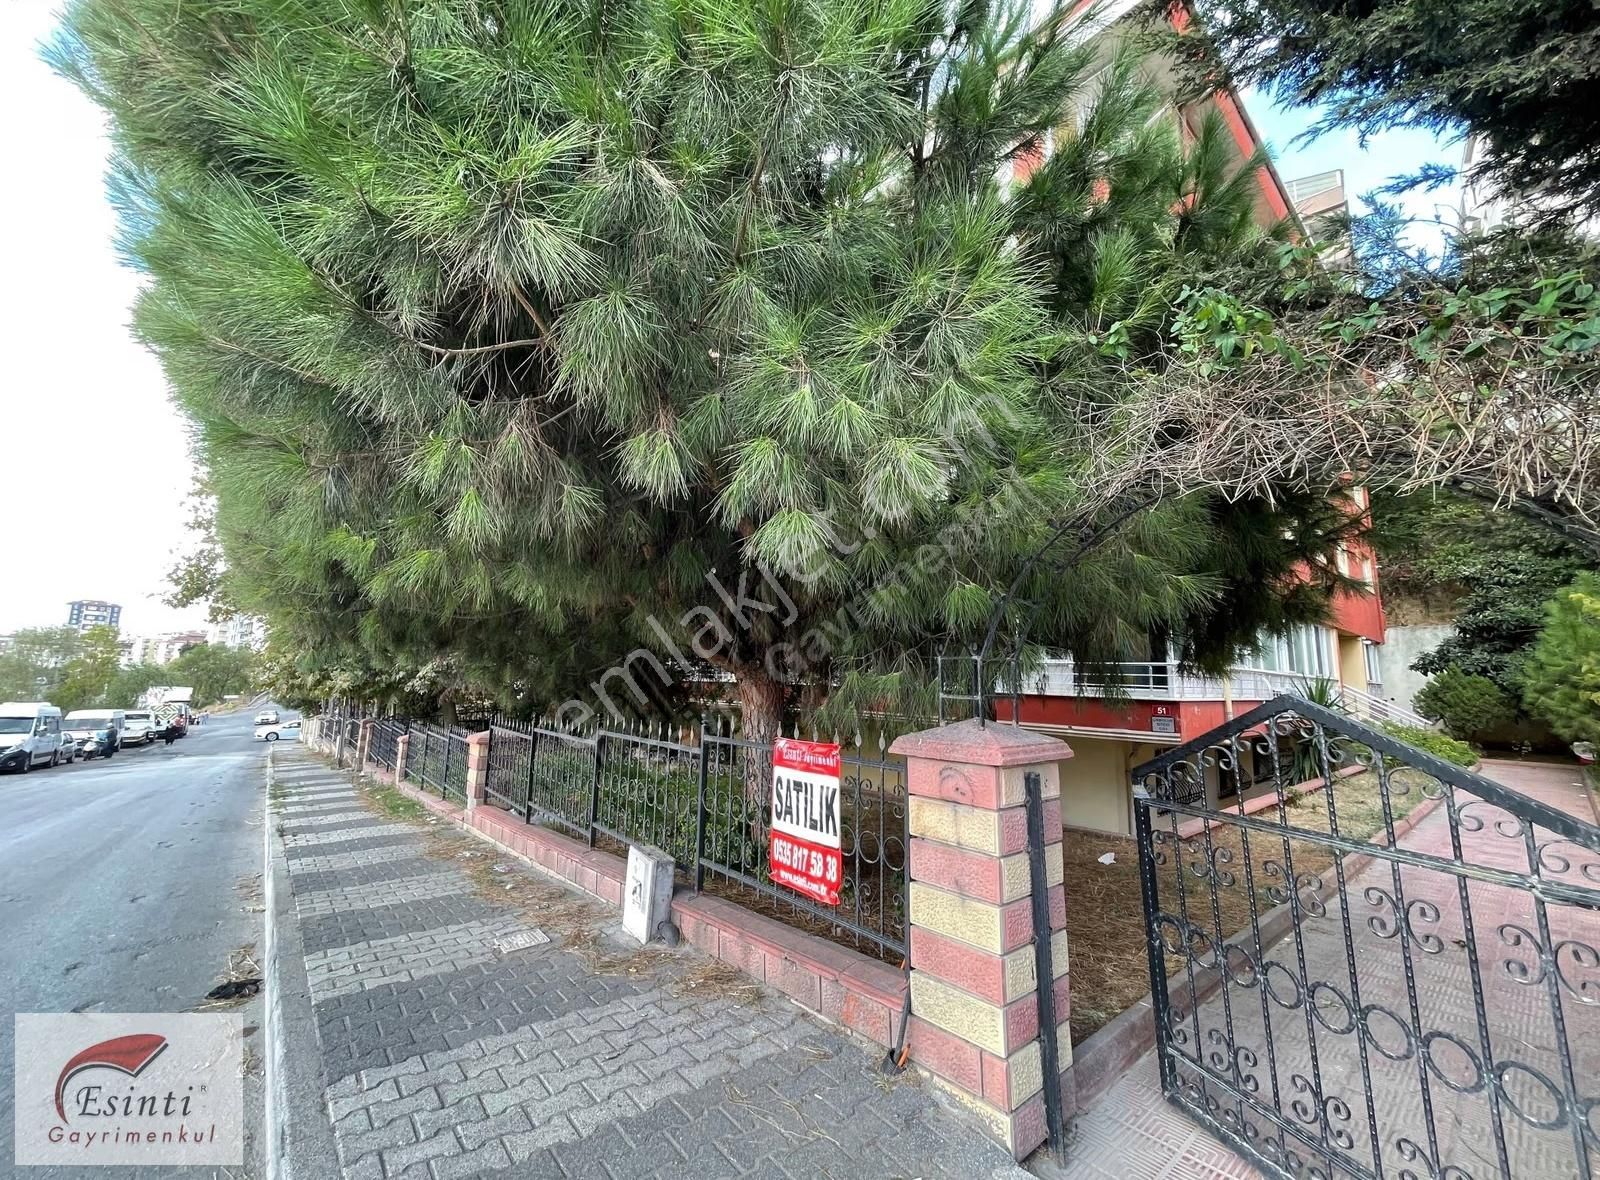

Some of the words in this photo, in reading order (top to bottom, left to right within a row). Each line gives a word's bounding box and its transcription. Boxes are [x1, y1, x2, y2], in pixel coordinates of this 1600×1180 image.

[1157, 706, 1166, 715] 51
[775, 776, 837, 837] SATILIK
[774, 838, 791, 866] 0535
[793, 845, 808, 872] 817
[810, 850, 823, 878] 58
[826, 855, 837, 883] 38
